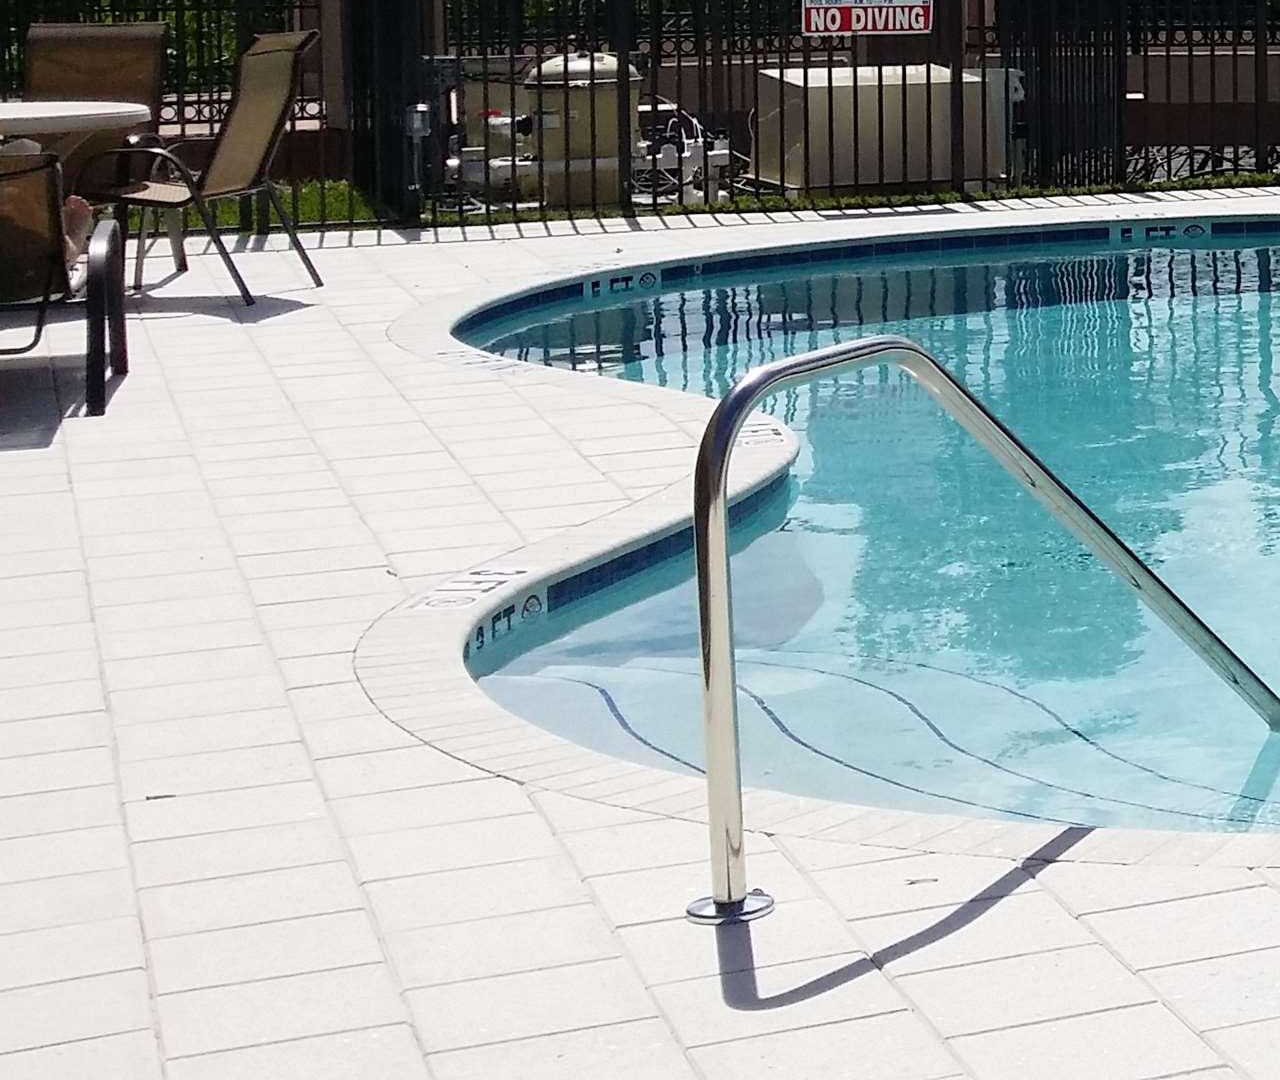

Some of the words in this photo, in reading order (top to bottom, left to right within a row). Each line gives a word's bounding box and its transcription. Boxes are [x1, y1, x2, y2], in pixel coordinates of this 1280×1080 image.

[810, 8, 841, 31] NO
[852, 7, 925, 30] DIVING
[492, 604, 516, 640] FT
